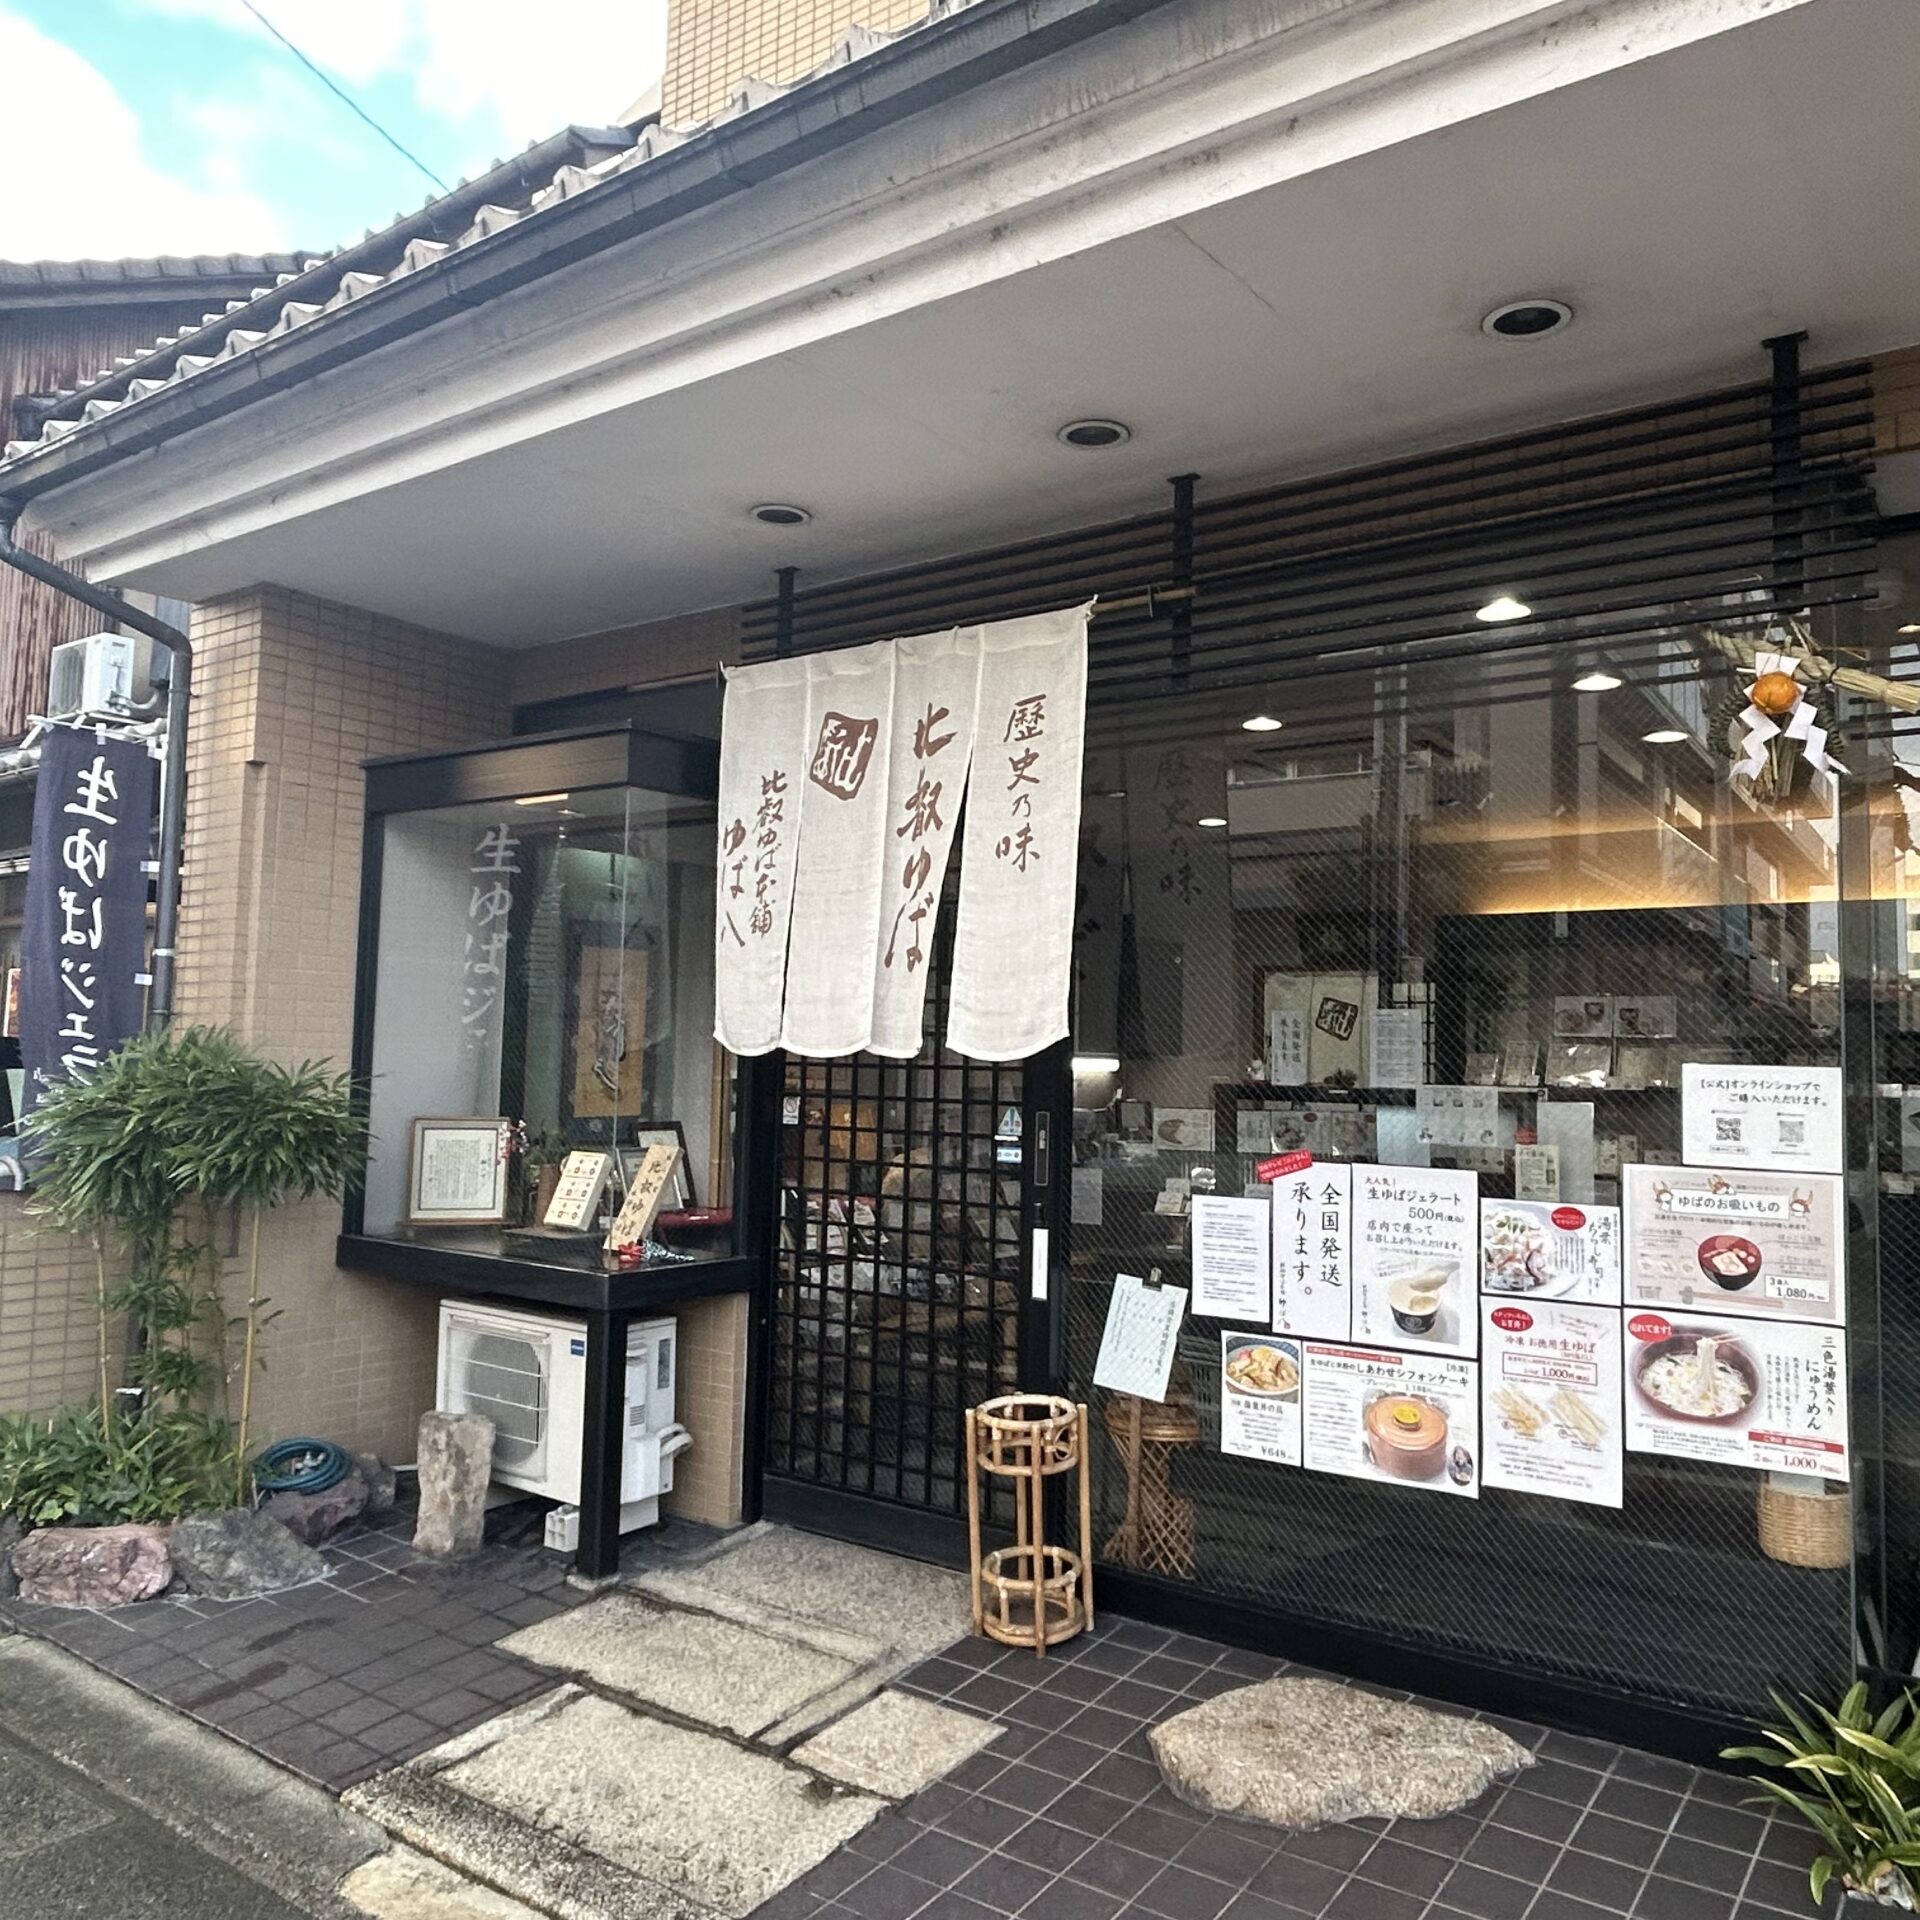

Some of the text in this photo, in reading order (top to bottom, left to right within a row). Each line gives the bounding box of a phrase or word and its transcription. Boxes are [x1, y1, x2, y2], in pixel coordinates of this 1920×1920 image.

[1367, 1186, 1461, 1206] 生ゆばジェラート
[1678, 1196, 1780, 1213] ゆばのお吸いもの
[1290, 1181, 1313, 1295] 承ります。
[1319, 1182, 1343, 1288] 全国発送
[1805, 1359, 1821, 1431] にゅうめん
